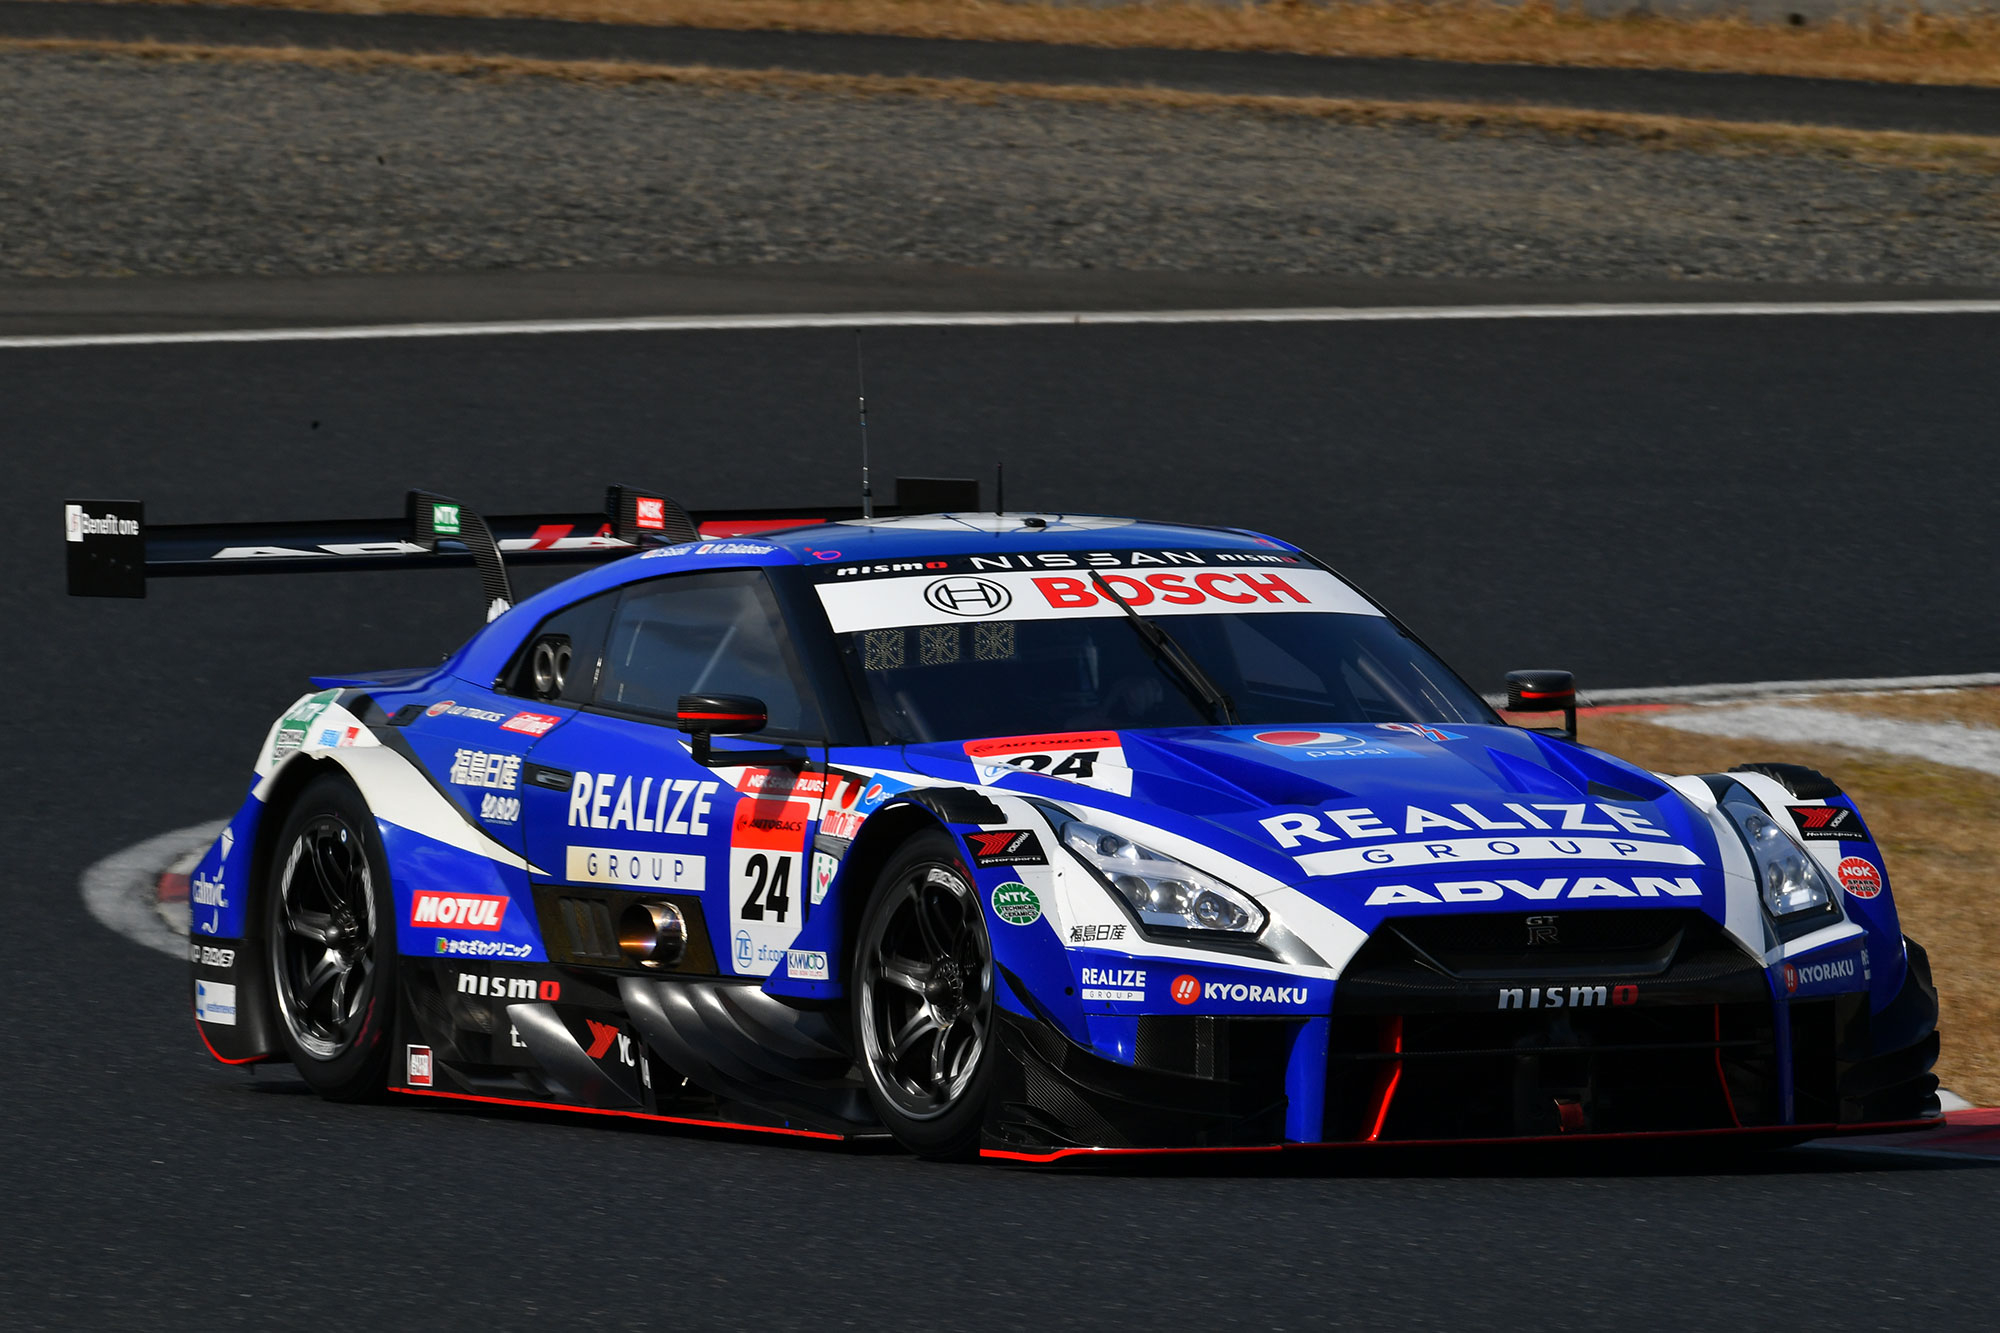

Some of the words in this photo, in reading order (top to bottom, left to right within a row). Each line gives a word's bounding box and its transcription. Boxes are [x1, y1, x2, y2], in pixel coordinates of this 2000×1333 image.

[82, 513, 119, 534] Benefit
[119, 520, 139, 535] one
[836, 562, 948, 576] nismo
[972, 550, 1206, 570] NISSAN
[1216, 554, 1298, 563] nismo
[1031, 572, 1312, 609] BOSCH
[1005, 751, 1099, 778] 24
[568, 771, 720, 836] REALIZE
[749, 818, 803, 832] AUTOBACS
[1258, 803, 1672, 849] REALIZE
[1362, 840, 1639, 864] GROUP
[587, 853, 684, 882] GROUP
[1841, 866, 1873, 877] NGK
[741, 853, 792, 923] 24
[998, 891, 1032, 903] NTK
[1364, 877, 1703, 906] ADVAN
[414, 896, 500, 926] MOTUL
[1001, 904, 1036, 912] TECHNICAL
[1526, 916, 1559, 925] GT
[1070, 925, 1127, 942] 福島日産
[448, 939, 533, 958] かなざわクリニック
[1082, 967, 1146, 987] REALIZE
[1798, 959, 1855, 984] KYORAKU
[457, 973, 561, 1001] nismo
[1089, 992, 1134, 1000] GROUP
[1204, 983, 1308, 1004] KYORAKU
[1498, 984, 1639, 1009] nismo
